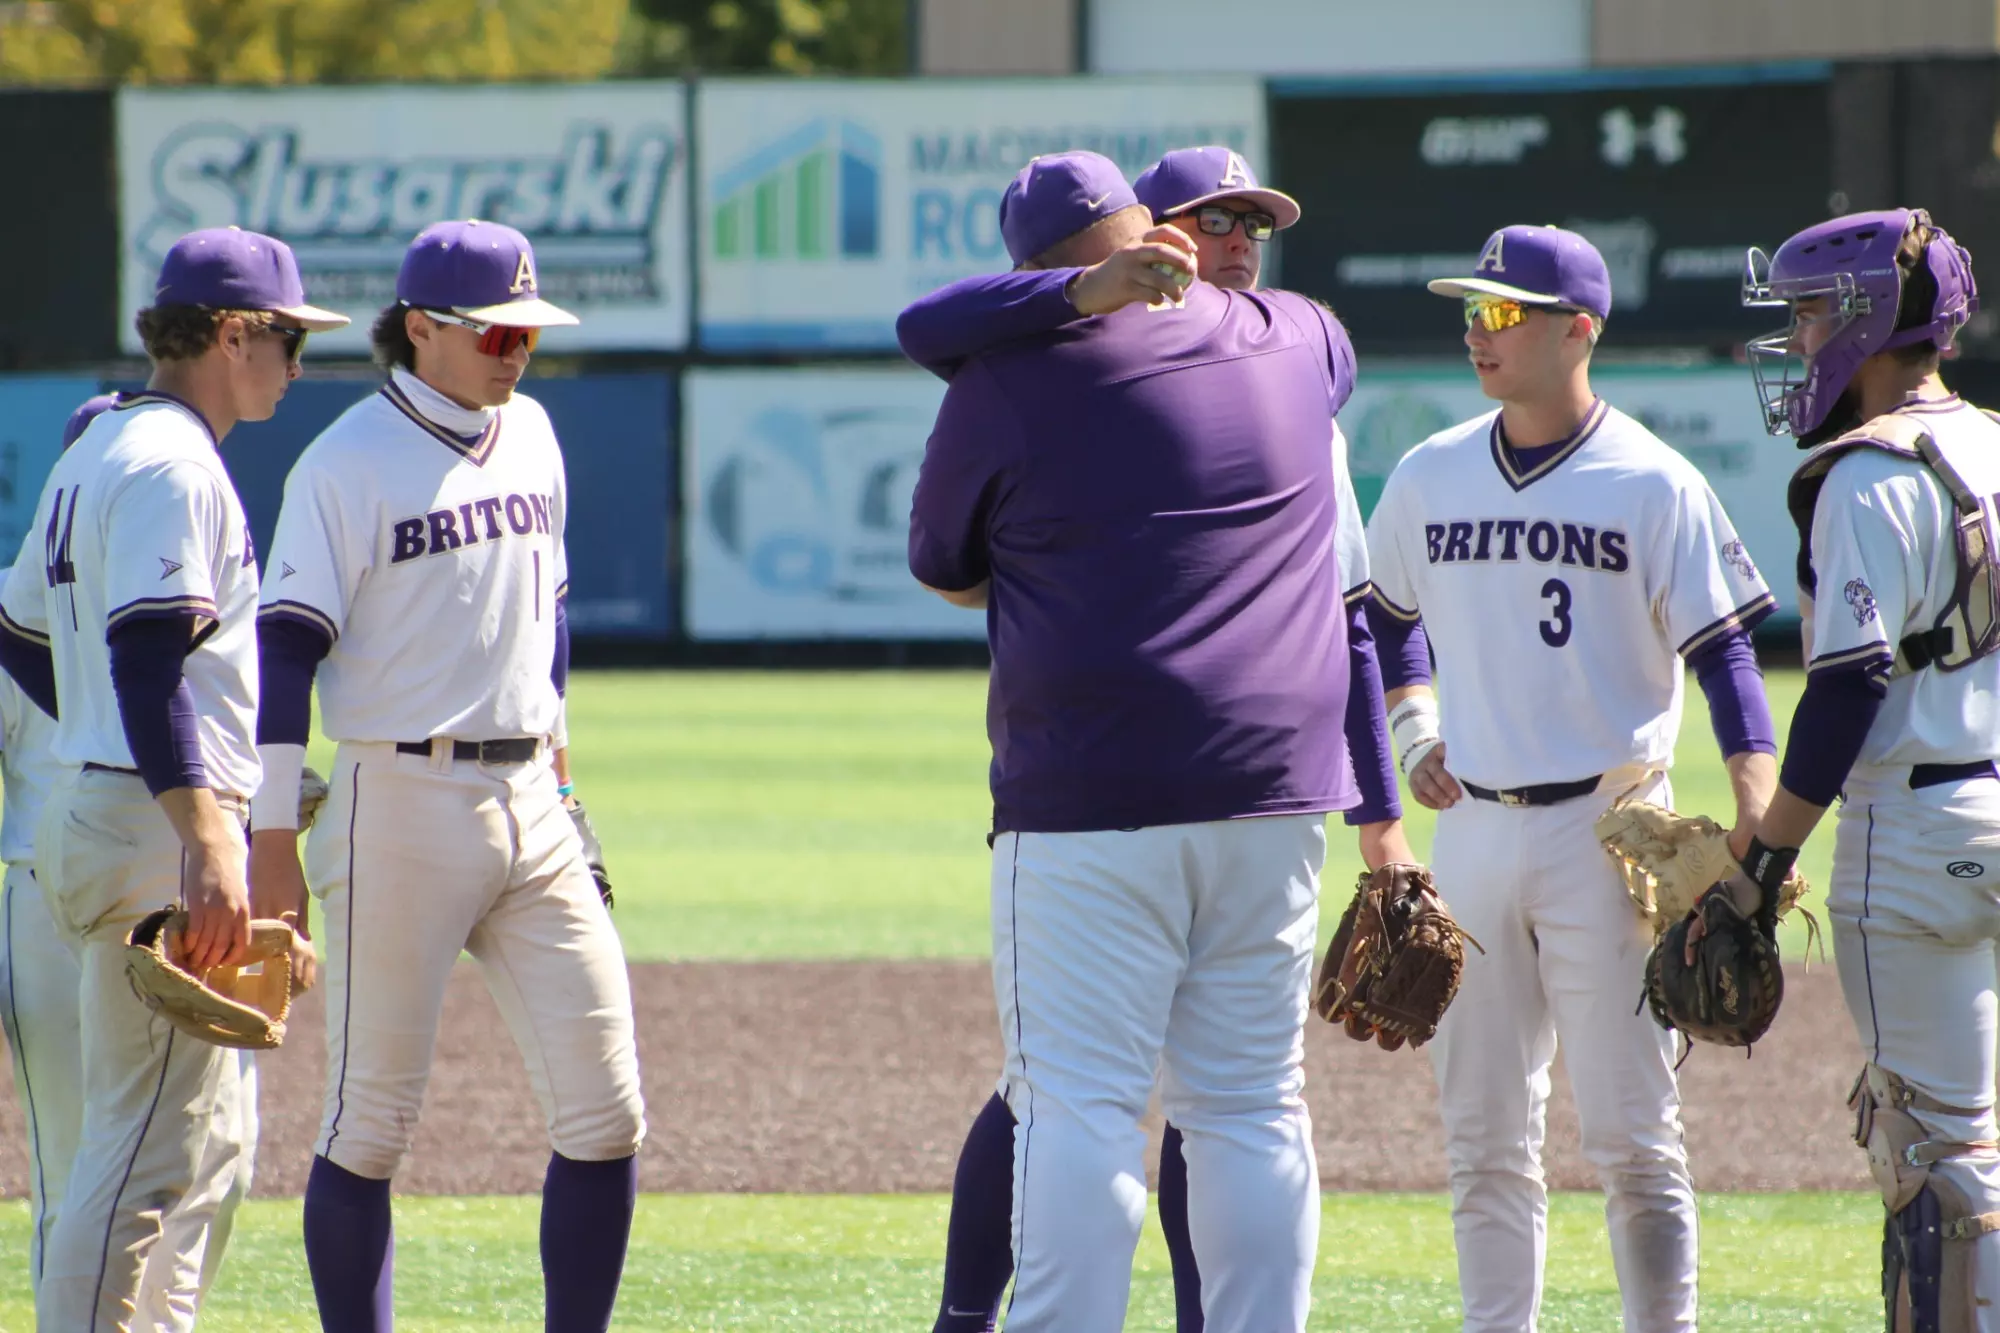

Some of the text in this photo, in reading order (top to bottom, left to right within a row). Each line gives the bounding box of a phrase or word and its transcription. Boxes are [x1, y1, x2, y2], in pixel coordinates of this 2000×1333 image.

[134, 118, 678, 272] Slusarski
[1217, 151, 1258, 189] A
[508, 251, 537, 294] A
[1475, 232, 1506, 272] A
[389, 492, 552, 566] BRITON
[1424, 518, 1630, 574] BRITONS
[1539, 577, 1573, 648] 3
